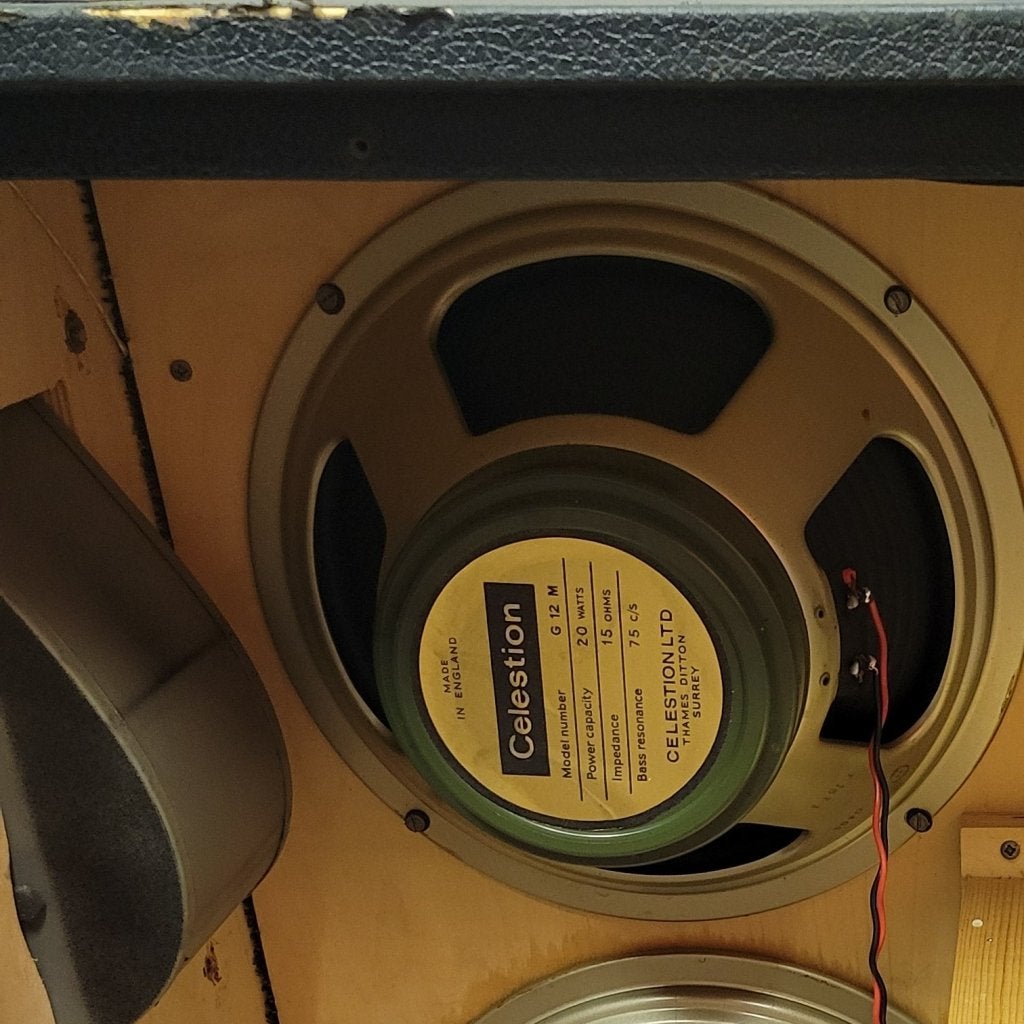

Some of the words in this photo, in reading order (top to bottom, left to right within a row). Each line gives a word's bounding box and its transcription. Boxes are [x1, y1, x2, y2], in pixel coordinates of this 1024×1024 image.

[547, 585, 558, 596] M
[575, 587, 585, 620] WATTS
[602, 589, 612, 622] OHMS
[550, 605, 560, 618] 12
[626, 604, 638, 622] c/s
[659, 608, 673, 646] LTD
[551, 626, 562, 636] G
[576, 626, 588, 646] 20
[601, 629, 613, 646] 15
[629, 629, 640, 647] 75
[441, 659, 452, 694] MADE
[448, 637, 463, 698] ENGLAND
[678, 635, 688, 685] DITTON
[501, 603, 535, 760] Celestion
[691, 666, 701, 718] SURREY
[456, 707, 466, 720] IN
[557, 690, 568, 736] number
[582, 688, 596, 738] capacity
[633, 688, 645, 750] resonance
[662, 648, 679, 763] CELESTION
[680, 694, 690, 746] THAMES
[560, 740, 572, 778] Model
[585, 740, 597, 780] Power
[609, 714, 624, 782] Impedance
[636, 754, 648, 782] Bass
